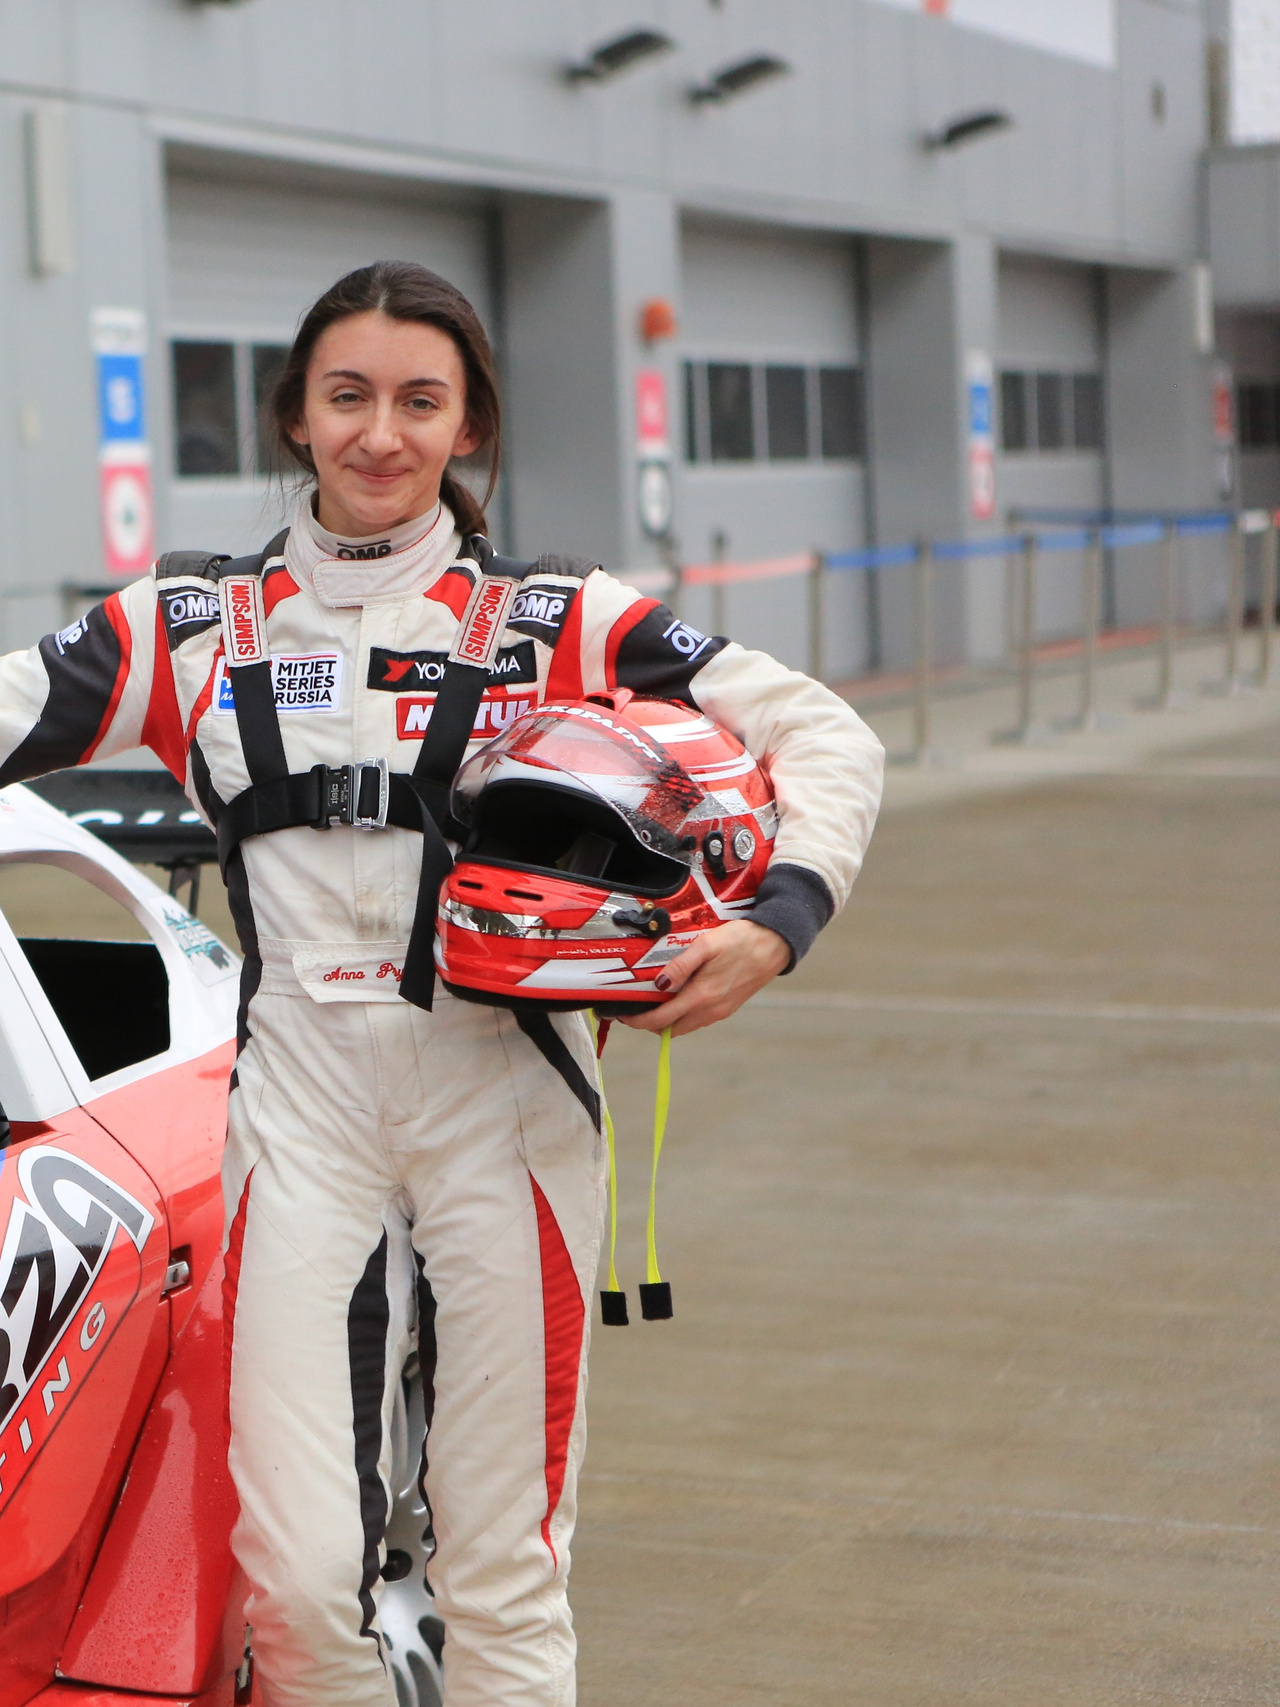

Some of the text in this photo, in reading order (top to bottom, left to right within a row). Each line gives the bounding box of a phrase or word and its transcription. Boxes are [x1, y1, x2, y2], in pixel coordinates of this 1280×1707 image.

[169, 595, 221, 621] OMP
[231, 584, 255, 656] SIMPSON
[465, 584, 506, 658] SIMPSON
[510, 595, 565, 621] OMP
[277, 660, 337, 677] MITJET
[414, 655, 521, 681] YOMA
[275, 675, 335, 691] SERIES
[275, 689, 333, 705] RUSSIA
[404, 700, 530, 732] MTU
[323, 962, 405, 982] Anna Pry
